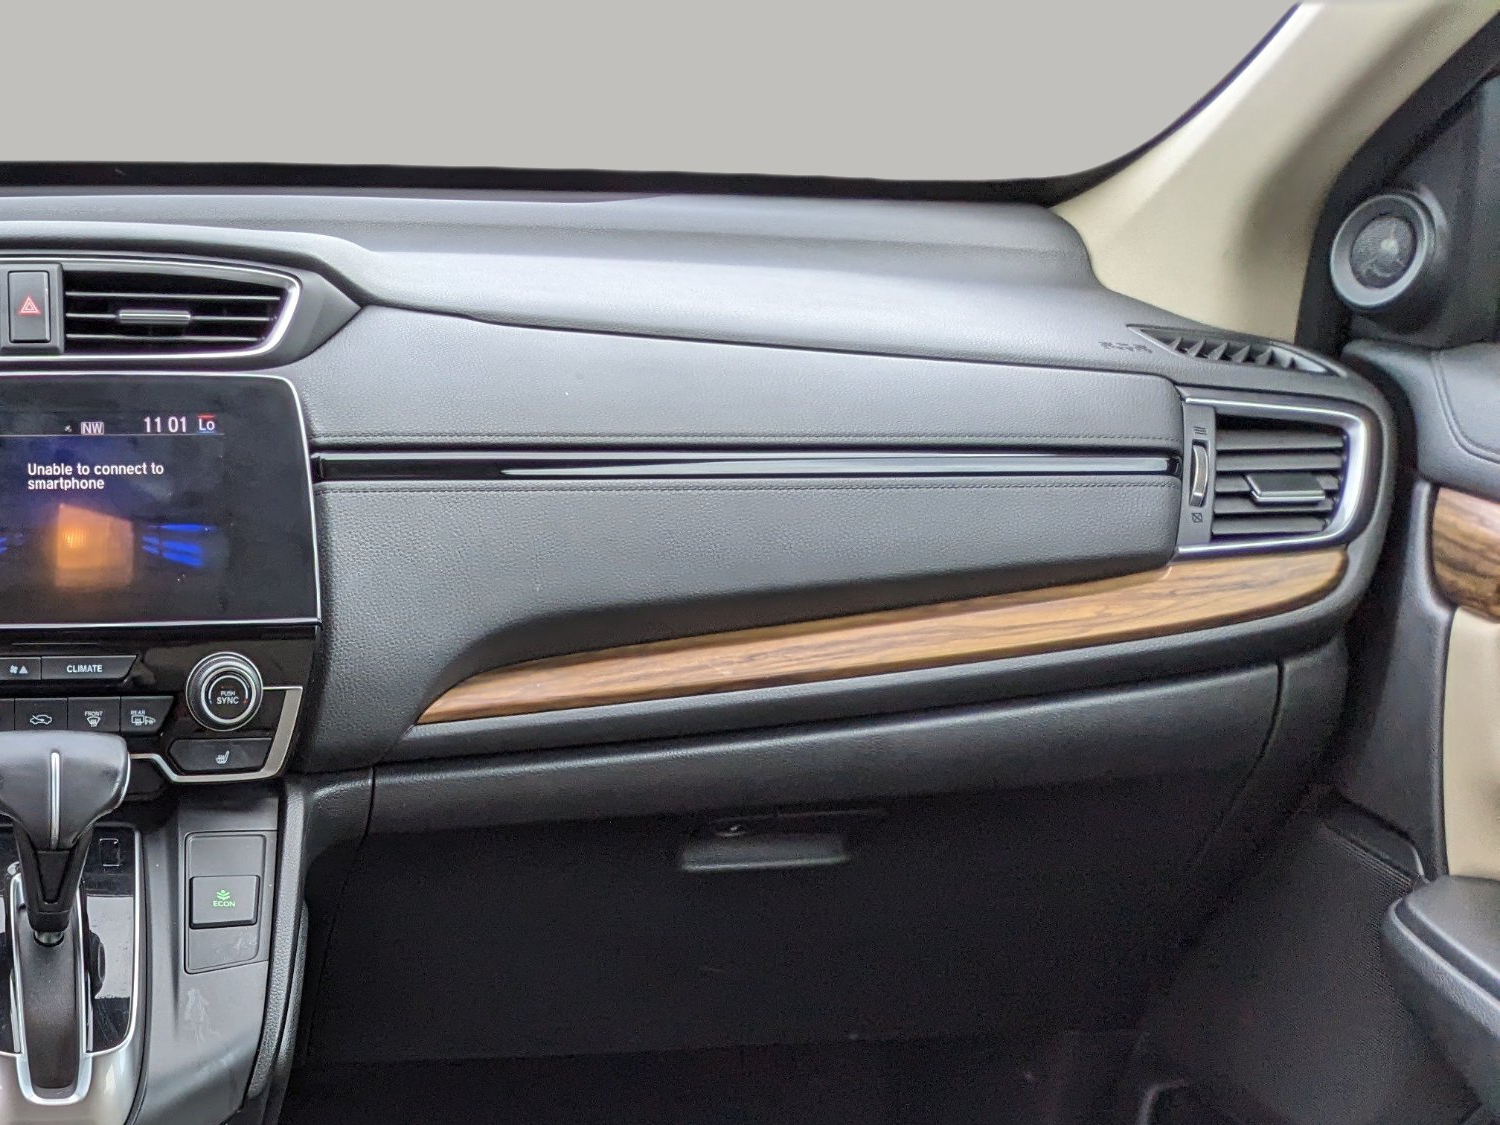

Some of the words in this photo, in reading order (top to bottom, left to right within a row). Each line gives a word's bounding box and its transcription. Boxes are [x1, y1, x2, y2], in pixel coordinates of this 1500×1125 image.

[82, 422, 103, 434] NW
[198, 418, 216, 431] Lo
[27, 462, 73, 476] Unable
[77, 462, 90, 476] to
[94, 462, 147, 476] connect
[151, 462, 164, 476] to
[27, 477, 105, 491] smartphone
[66, 664, 103, 673] CLIMATE
[216, 697, 240, 706] SYNC
